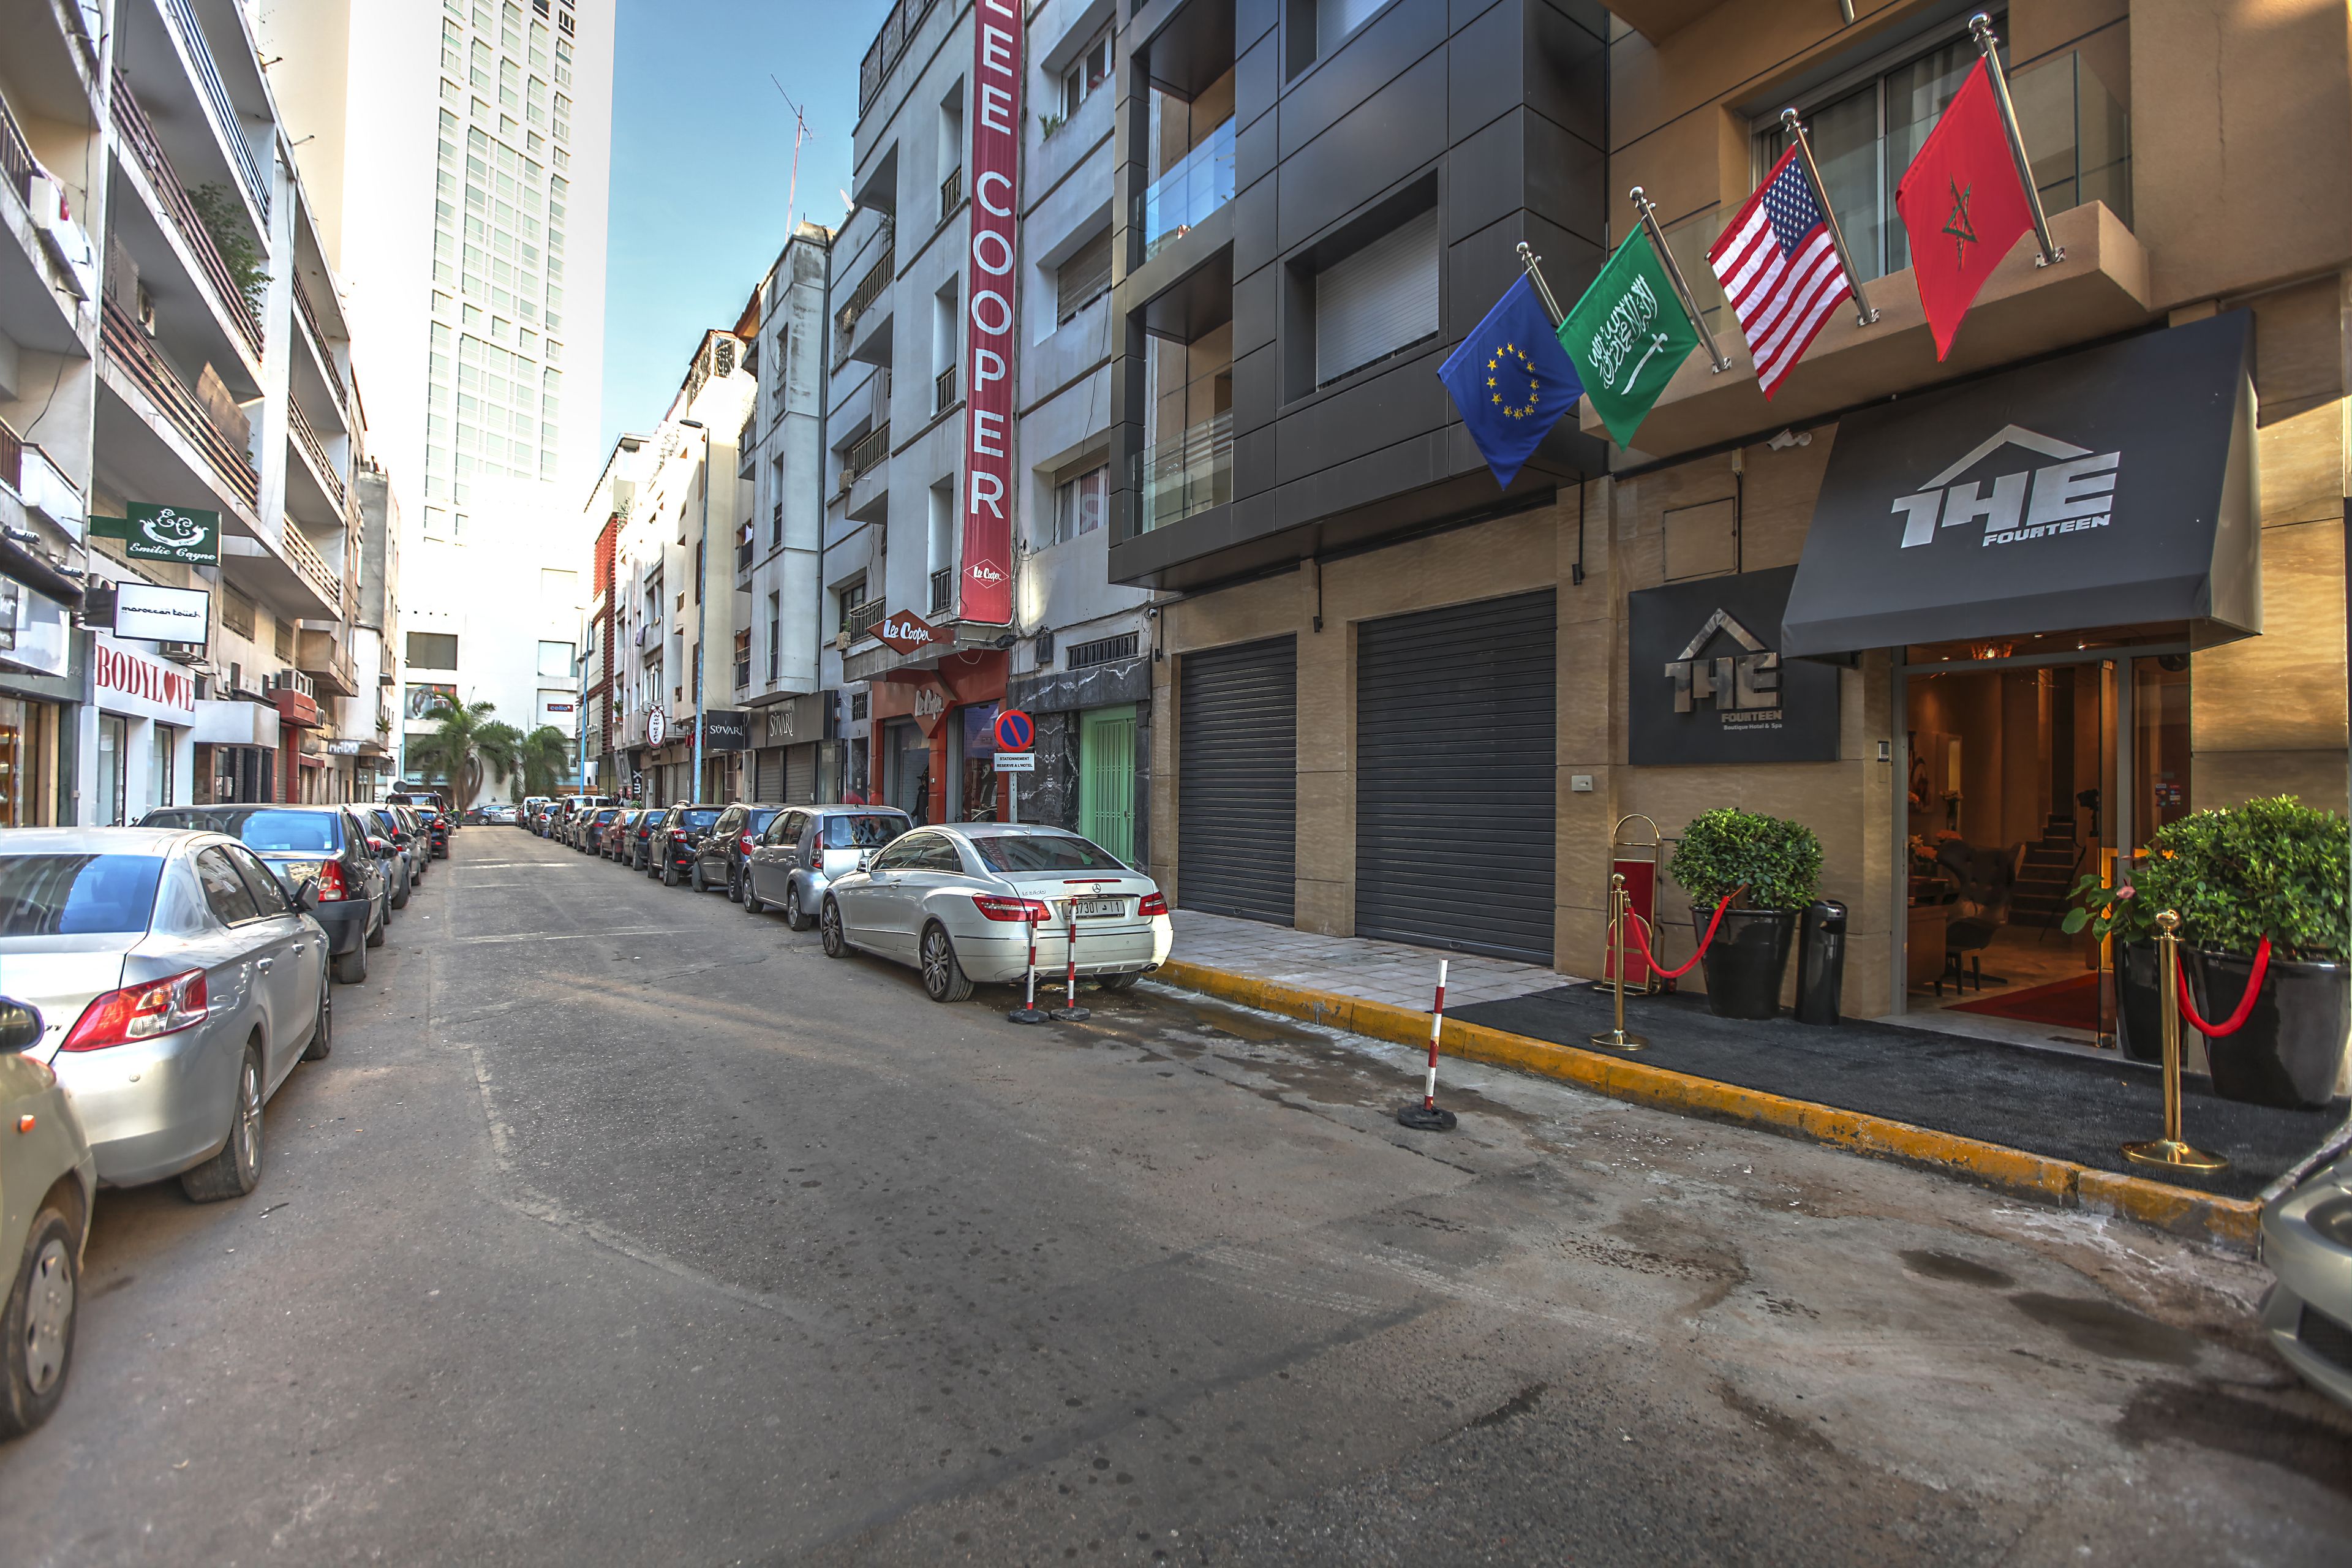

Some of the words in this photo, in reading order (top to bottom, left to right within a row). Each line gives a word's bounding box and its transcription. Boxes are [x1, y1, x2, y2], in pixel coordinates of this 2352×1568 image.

[971, 171, 1013, 519] COOPER
[1982, 514, 2111, 547] FOURTEEN
[973, 566, 982, 578] Lee
[983, 567, 1002, 582] Cooper
[883, 619, 899, 638] Lee
[900, 622, 933, 645] Cooper
[1721, 710, 1782, 723] FOURTEEN
